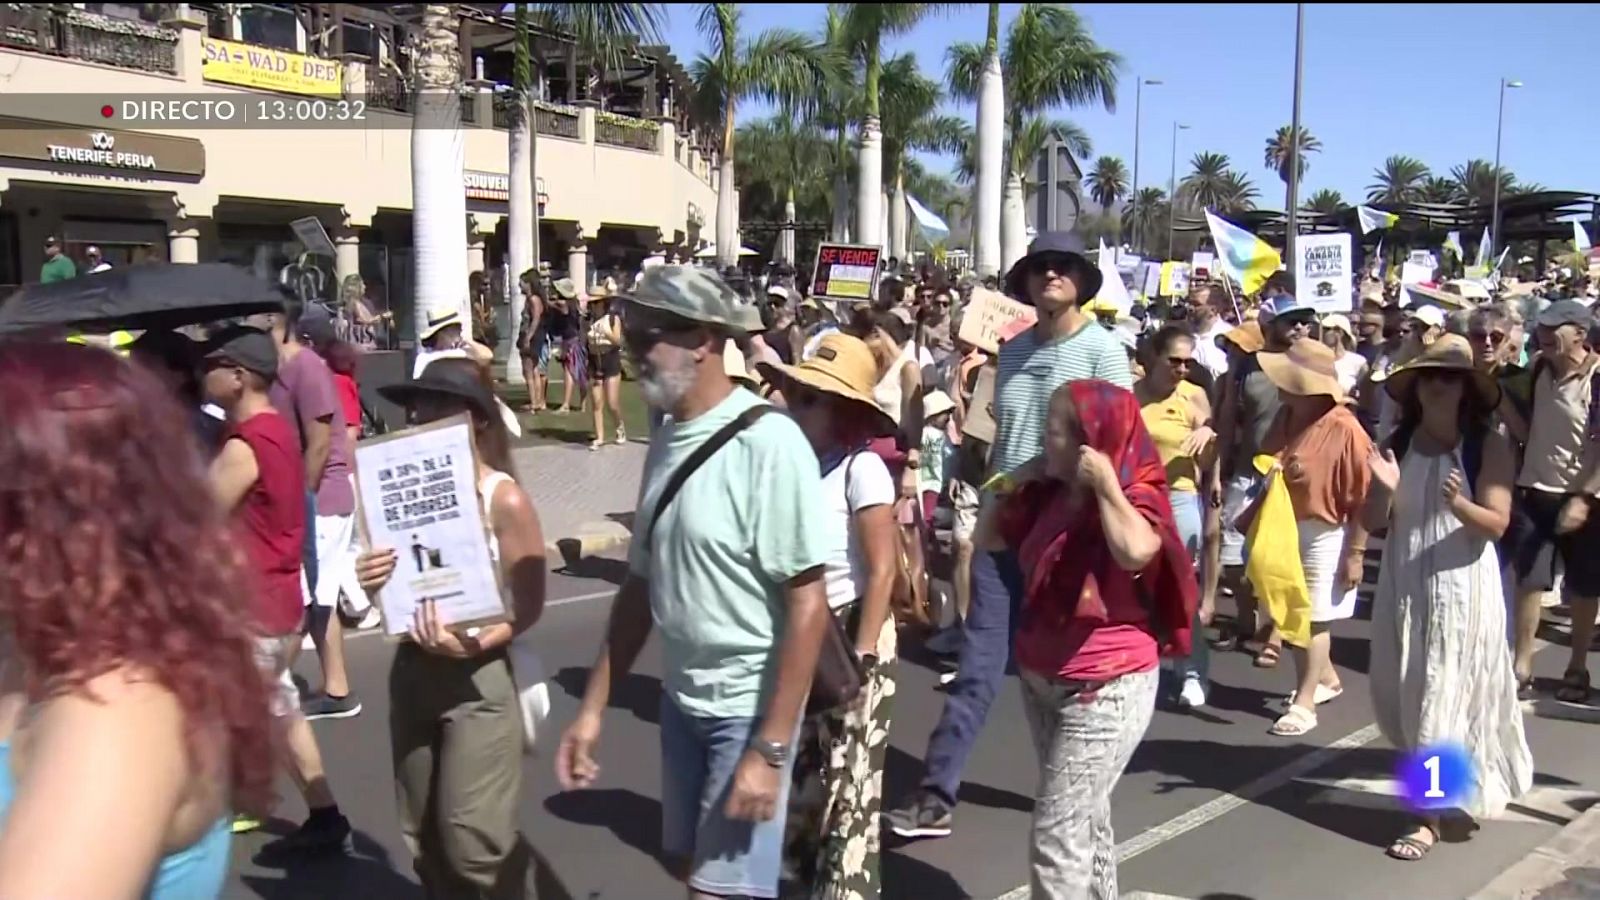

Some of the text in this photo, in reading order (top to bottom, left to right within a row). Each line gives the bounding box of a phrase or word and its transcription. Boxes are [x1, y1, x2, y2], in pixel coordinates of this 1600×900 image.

[205, 42, 230, 63] SA
[247, 51, 288, 73] WAD
[303, 61, 337, 81] DEE
[48, 145, 156, 168] TENERIFE PERLA
[463, 174, 509, 191] SOUVEN
[821, 249, 877, 266] SE VENDE
[383, 506, 401, 522] DE
[403, 494, 458, 516] POBREZA
